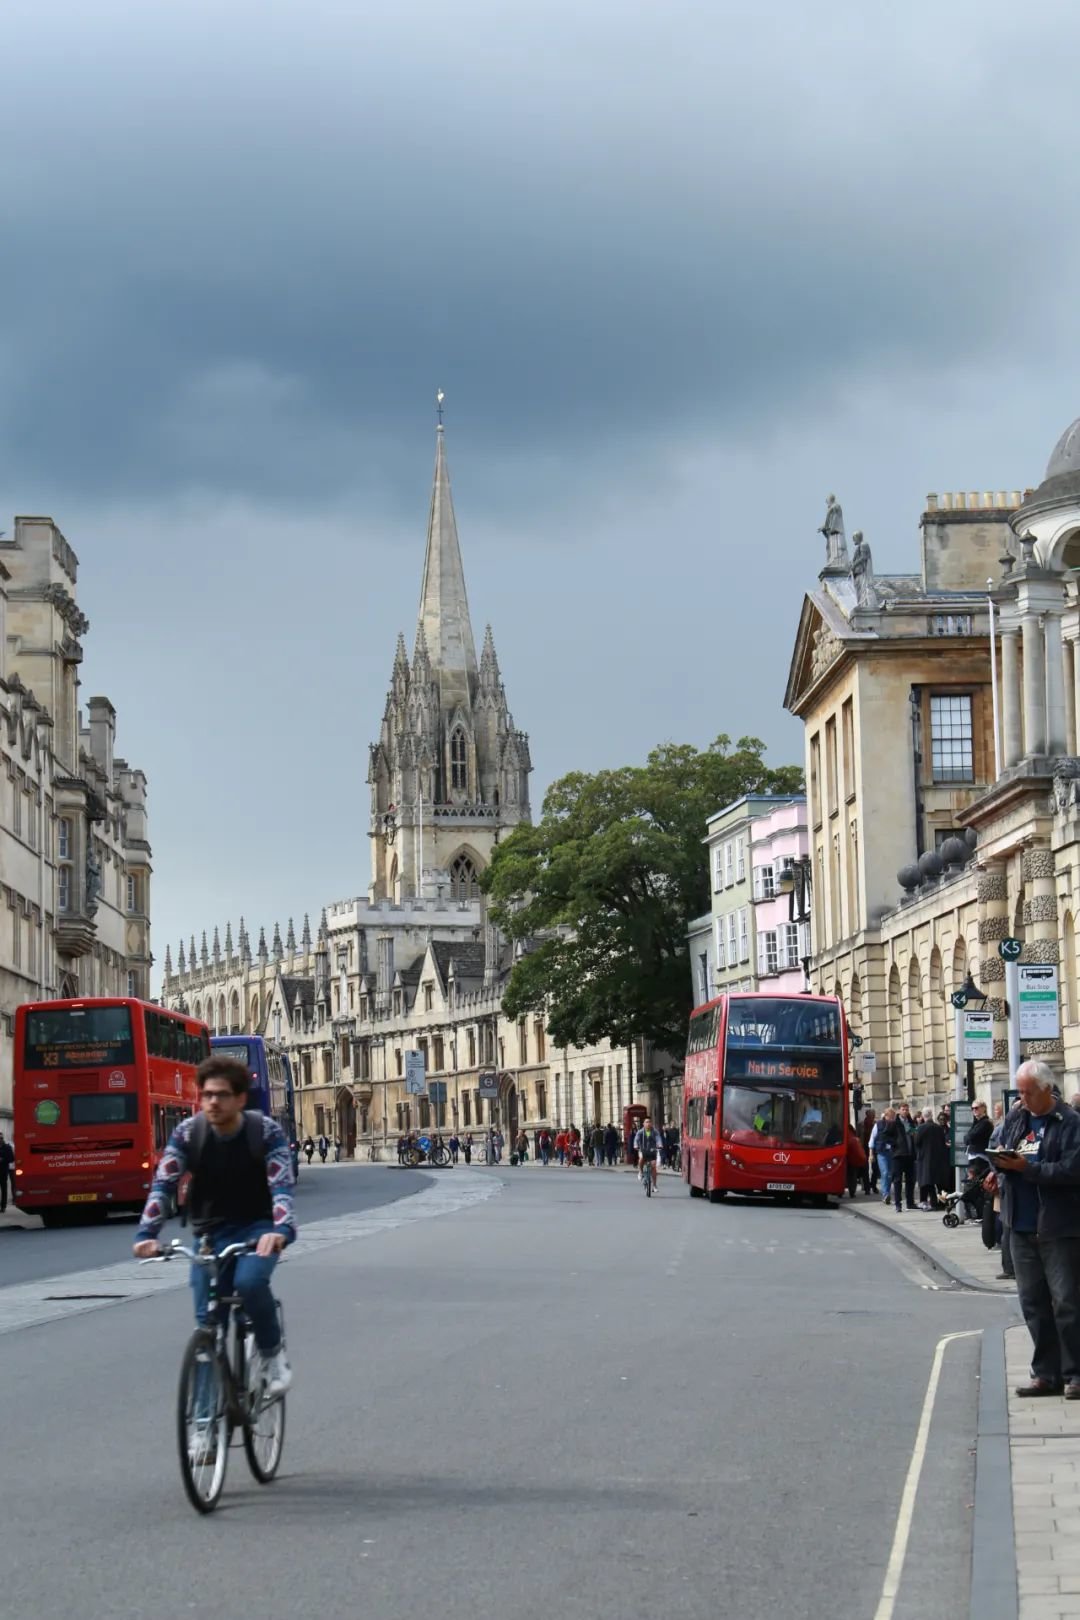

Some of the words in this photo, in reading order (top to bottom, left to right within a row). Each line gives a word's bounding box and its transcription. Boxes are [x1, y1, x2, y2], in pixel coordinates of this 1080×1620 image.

[1001, 941, 1020, 954] K5
[952, 995, 966, 1004] K4
[43, 1052, 59, 1066] X3
[748, 1060, 765, 1074] Not
[768, 1063, 776, 1075] in
[779, 1062, 818, 1077] Service
[773, 1152, 791, 1164] city
